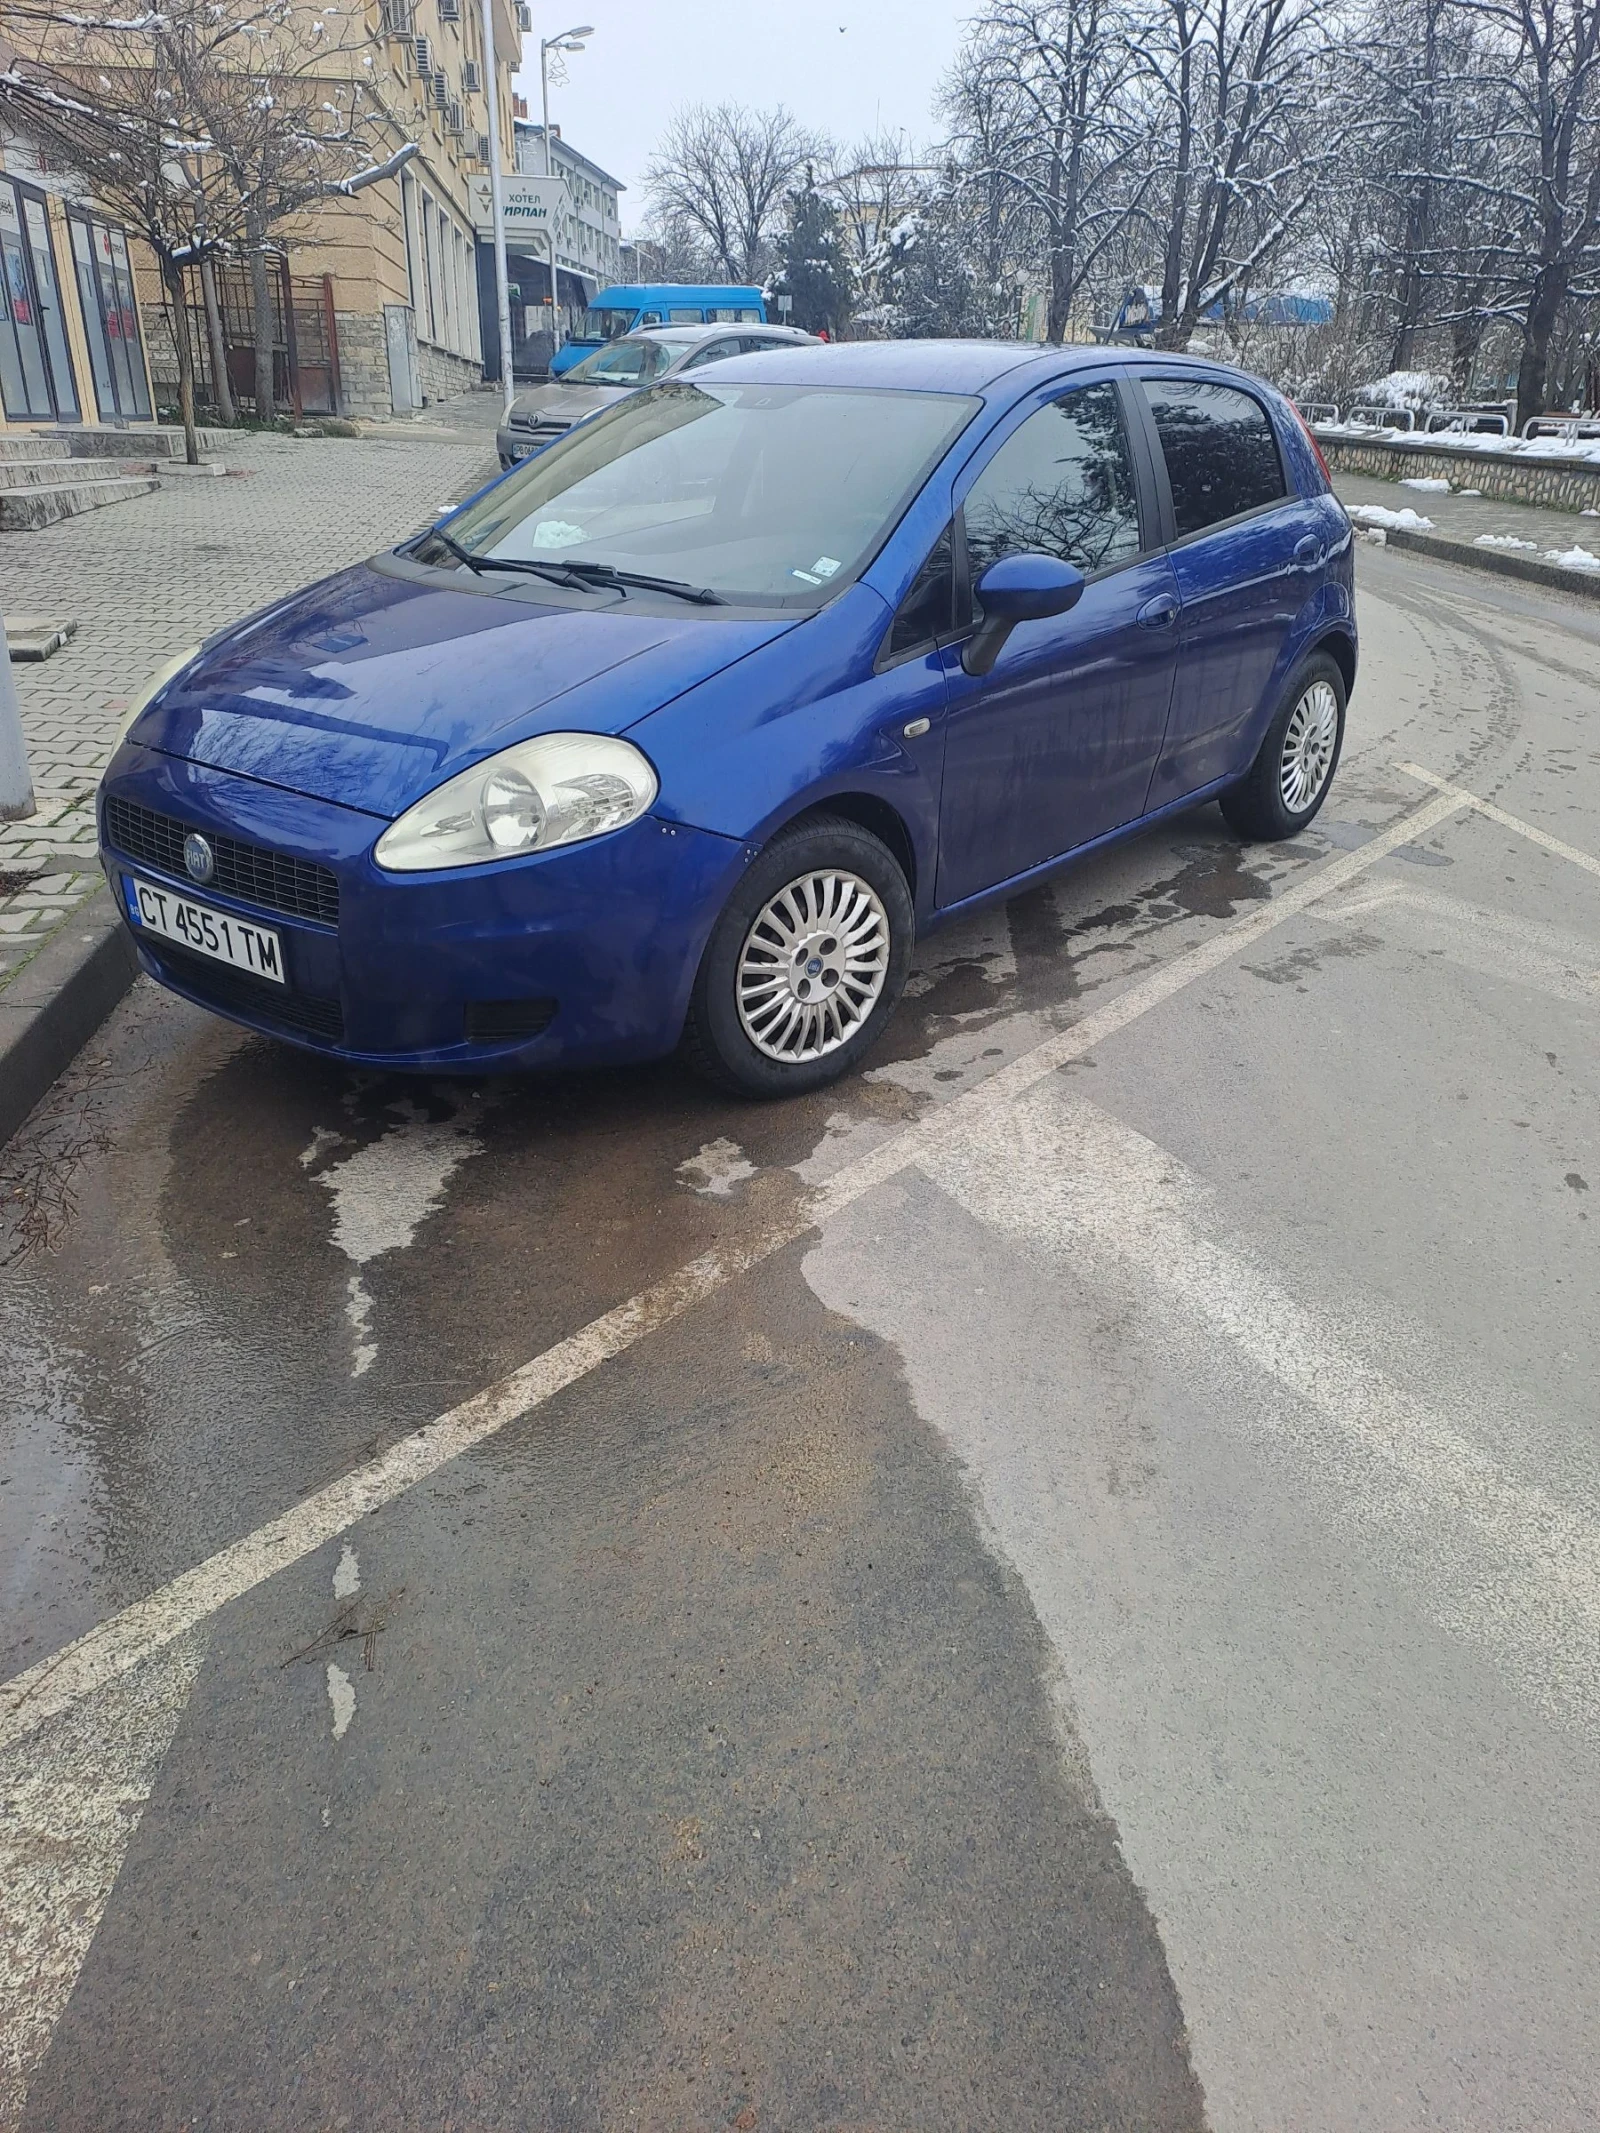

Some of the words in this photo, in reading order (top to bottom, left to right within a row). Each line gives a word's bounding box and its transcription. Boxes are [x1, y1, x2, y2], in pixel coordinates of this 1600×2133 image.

[508, 194, 541, 204] ХОТЕЛ
[503, 205, 547, 218] ИРПАН
[186, 849, 205, 869] FIAT
[129, 903, 140, 917] BG
[139, 887, 168, 932] CT
[176, 902, 234, 960] 4551
[237, 925, 279, 976] TM
